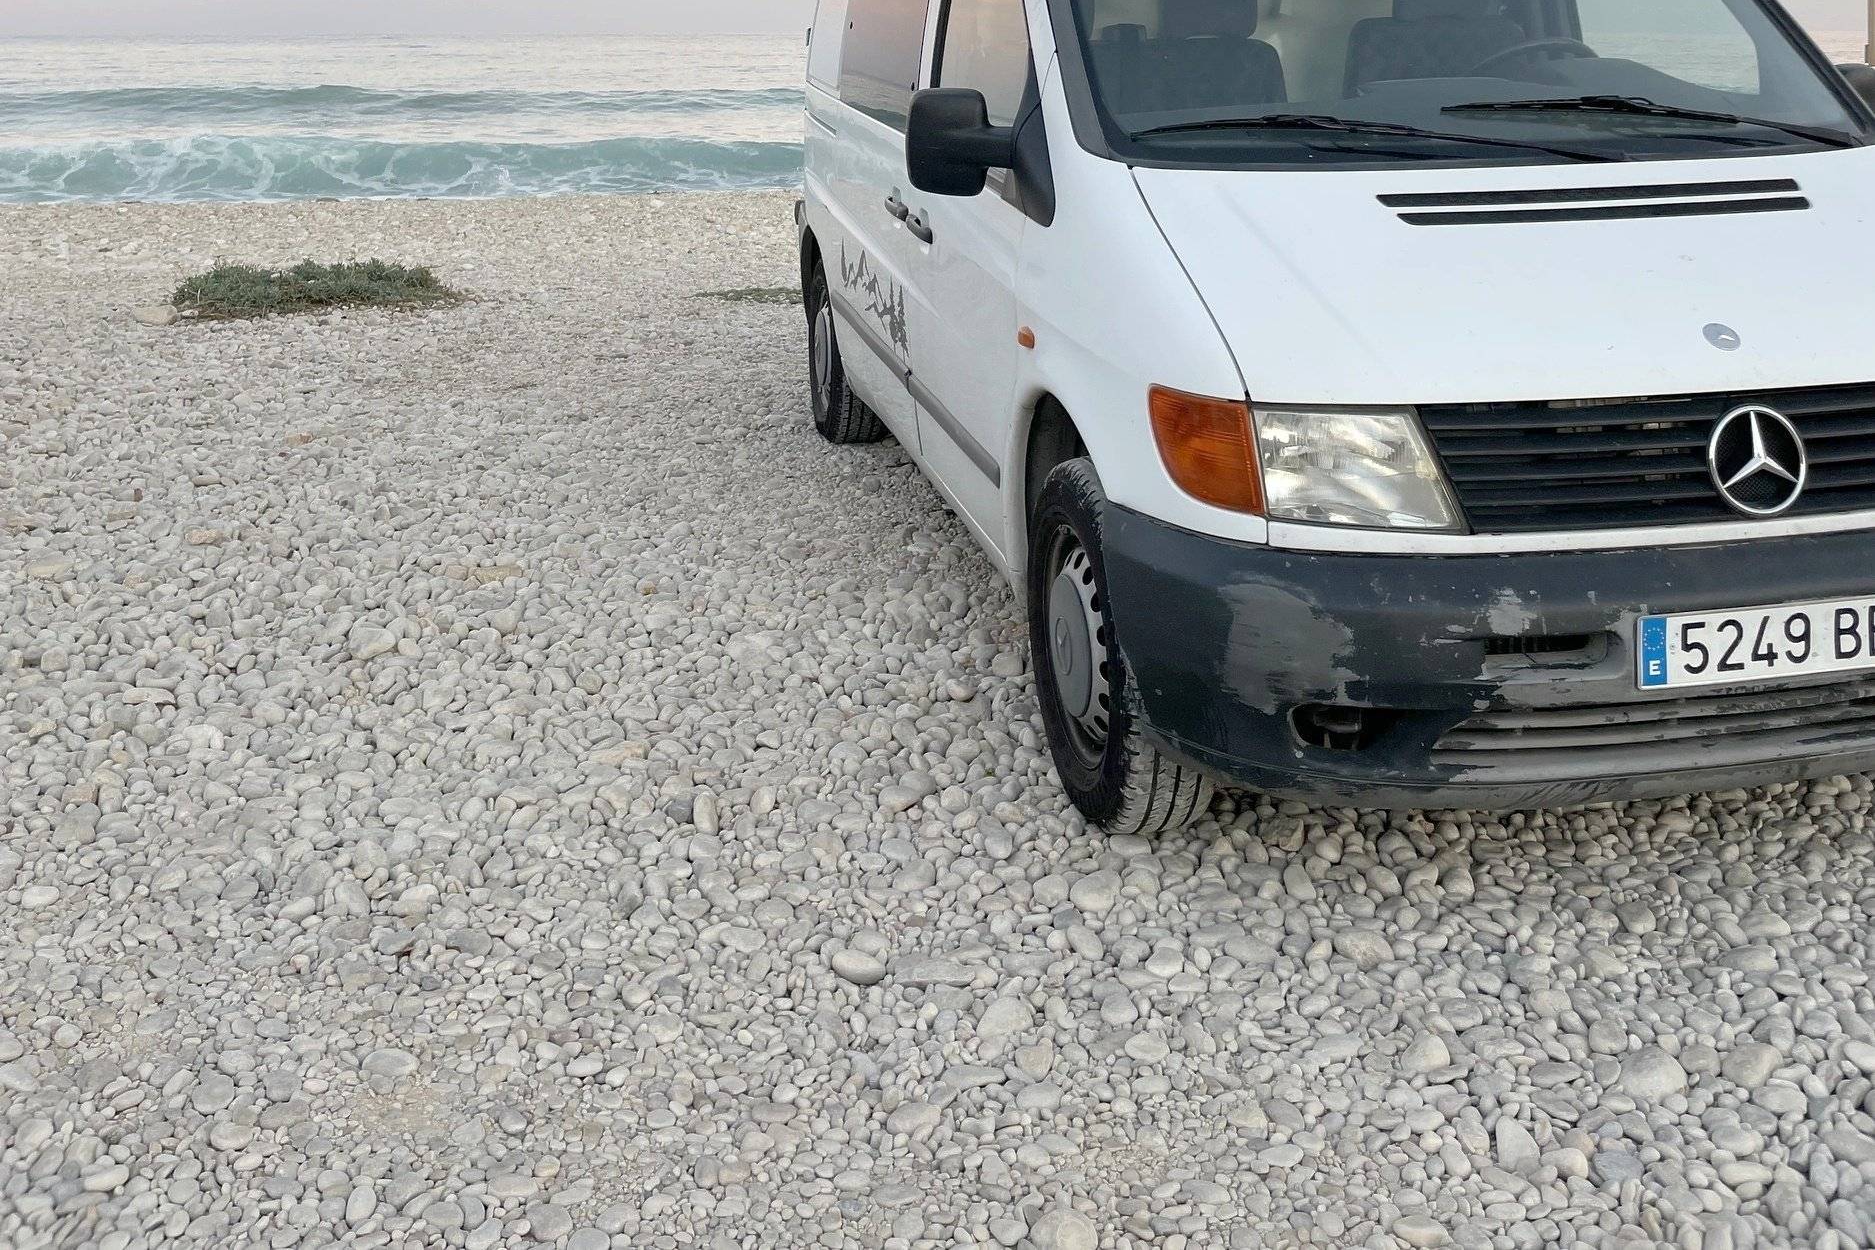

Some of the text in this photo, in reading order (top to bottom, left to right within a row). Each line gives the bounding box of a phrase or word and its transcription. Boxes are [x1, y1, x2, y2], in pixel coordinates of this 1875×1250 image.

[1681, 606, 1875, 675] 5249 B
[1649, 660, 1660, 675] E
